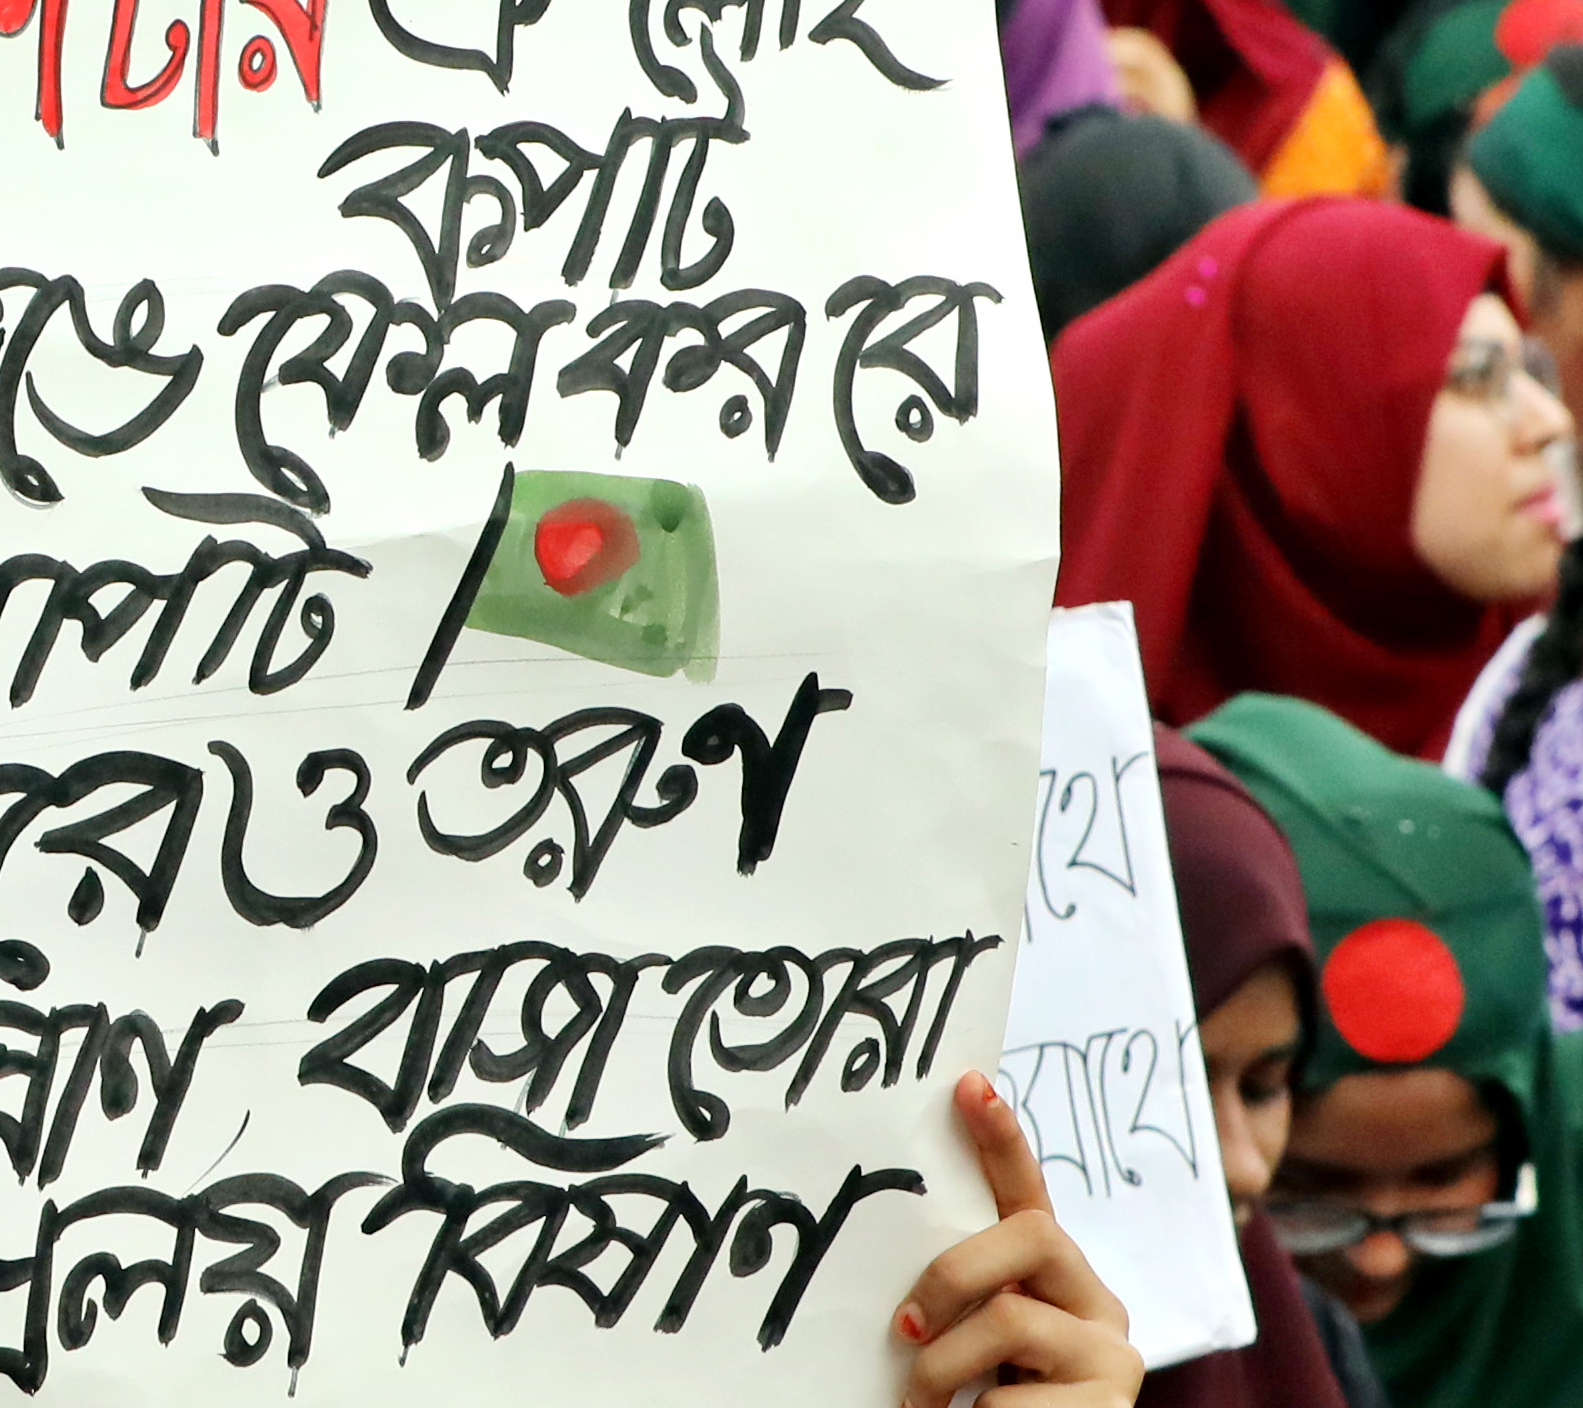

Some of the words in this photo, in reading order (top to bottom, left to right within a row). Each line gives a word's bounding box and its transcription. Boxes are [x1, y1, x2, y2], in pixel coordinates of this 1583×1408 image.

[317, 21, 750, 308] কপাট
[217, 270, 577, 515] ফেল
[406, 671, 854, 902] তরুণ
[297, 939, 674, 1134] বাজা
[360, 1102, 928, 1365] বিষাণ
